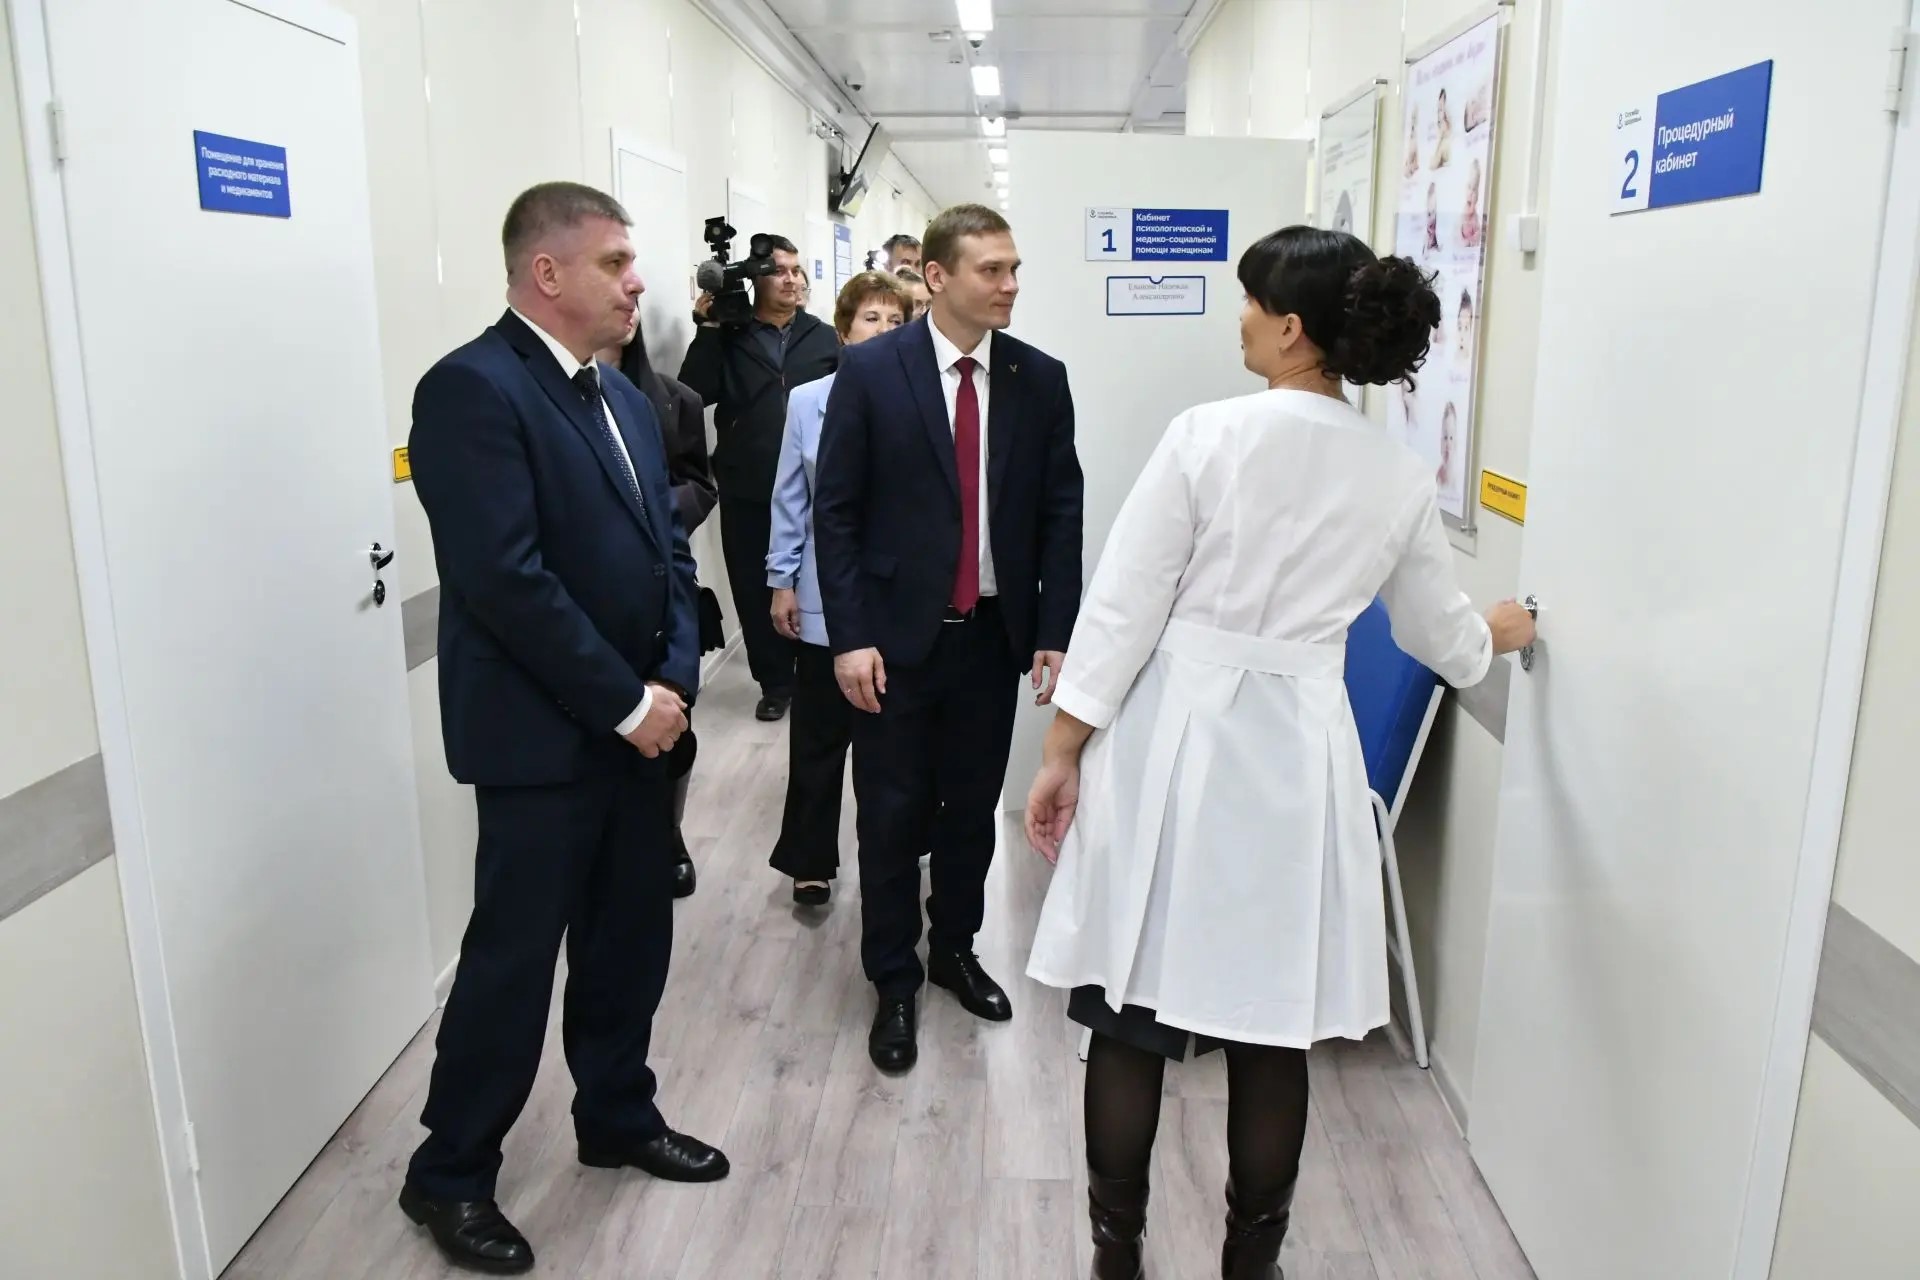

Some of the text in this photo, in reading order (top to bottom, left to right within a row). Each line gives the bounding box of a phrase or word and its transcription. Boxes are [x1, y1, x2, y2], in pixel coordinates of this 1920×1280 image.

[1657, 107, 1735, 149] Процедурный
[201, 146, 242, 164] Помещение
[242, 156, 255, 167] для
[1654, 151, 1699, 175] кабинет
[208, 166, 282, 186] расходного материала
[1620, 149, 1639, 199] 2
[226, 185, 273, 199] медикаментов
[1136, 213, 1171, 222] Кабинет
[1136, 225, 1206, 234] психологической
[1136, 235, 1217, 244] медико-социальной
[1101, 228, 1117, 252] 1
[1136, 247, 1214, 255] помощи женщинам
